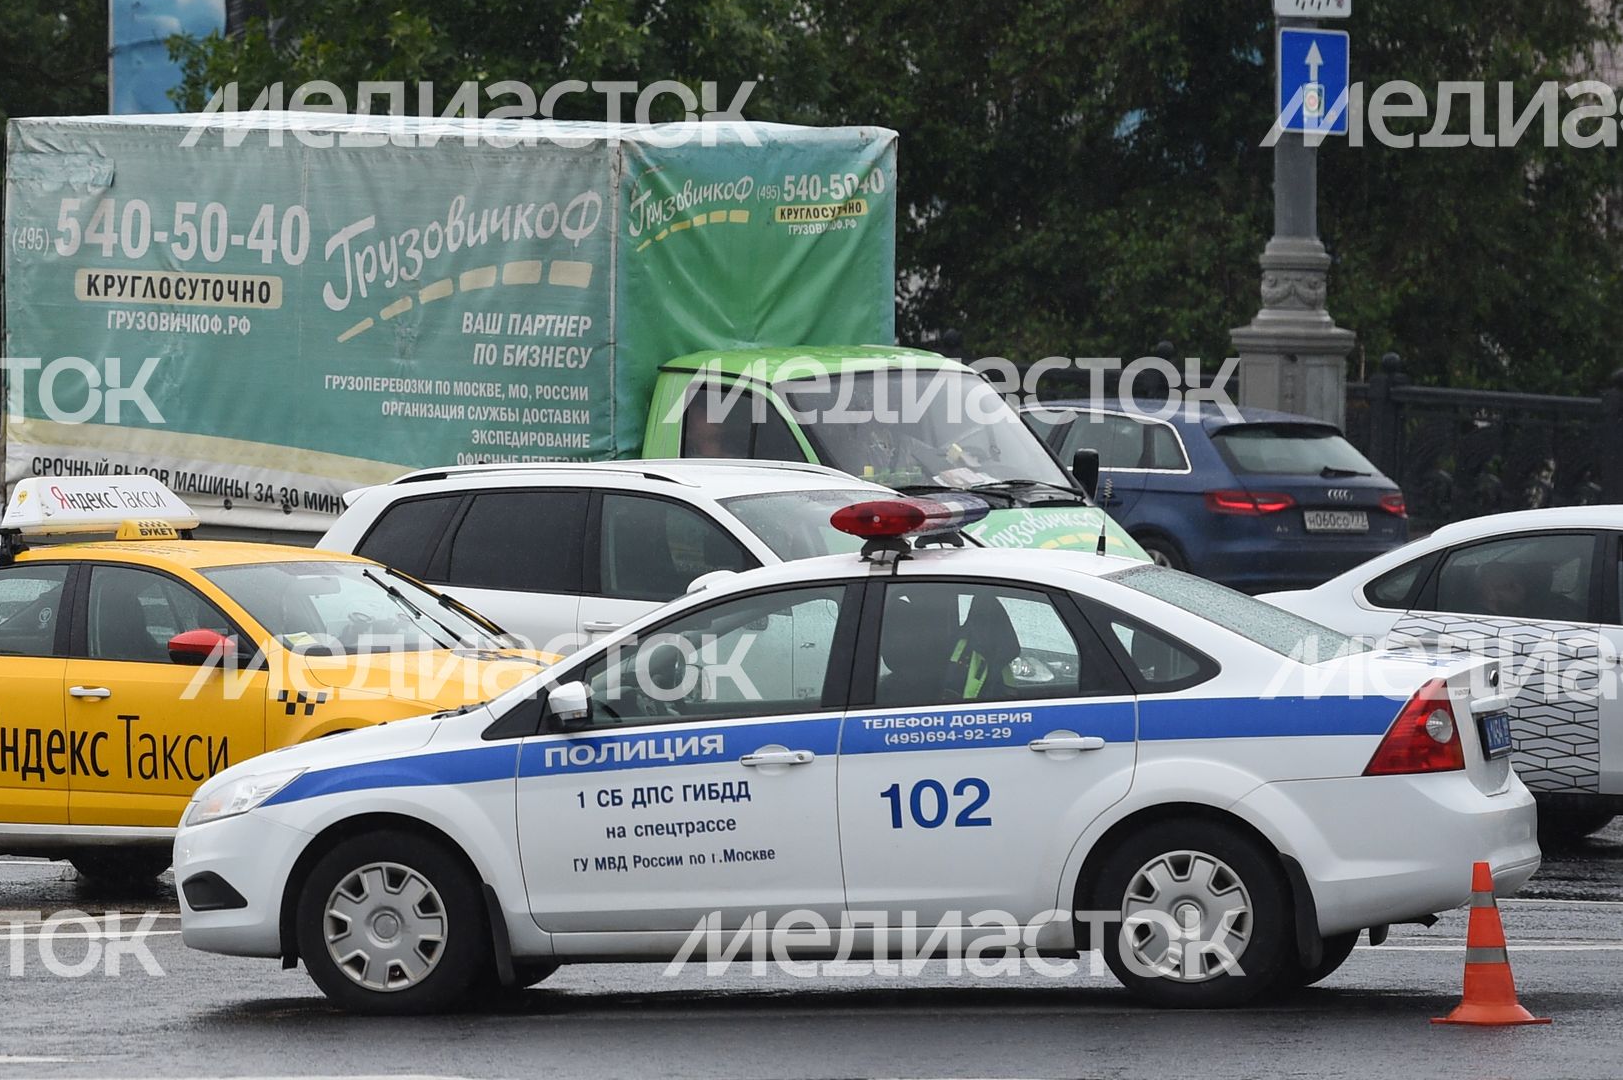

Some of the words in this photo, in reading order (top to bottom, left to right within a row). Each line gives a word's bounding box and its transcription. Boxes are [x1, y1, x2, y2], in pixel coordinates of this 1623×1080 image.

[757, 185, 780, 202] (495)
[12, 226, 50, 256] (495)
[54, 198, 310, 265] 540-50-40
[86, 273, 271, 304] КРУГЛОСУТОЧНО
[107, 310, 251, 336] ГРУЗОВИЧКОФ.РФ
[461, 311, 503, 334] ВАШ
[507, 313, 592, 338] ПАРТНЕР
[473, 343, 497, 366] ПО
[503, 344, 593, 369] БИЗНЕСУ
[325, 375, 432, 395] ГРУЗОПЕРЕВОЗКИ
[435, 380, 450, 396] ПО
[453, 381, 505, 401] МОСКВЕ,
[508, 384, 532, 402] МО,
[535, 385, 589, 401] РОССИИ
[381, 401, 465, 422] ОРГАНИЗАЦИЯ
[467, 405, 519, 421] СЛУЖБЫ
[522, 407, 590, 425] ДОСТАВКИ
[471, 429, 591, 449] ЭКСПЕДИРОВАНИЕ
[32, 457, 109, 477] СРОЧНЫЙ
[174, 470, 250, 500] МАШИНЫ
[253, 482, 275, 503] ЗА
[280, 486, 299, 508] 30
[50, 486, 117, 512] Яндекс
[109, 485, 166, 510] Такси
[138, 527, 174, 537] БУКЕТ
[863, 716, 944, 729] ТЕЛЕФОН
[950, 712, 1032, 727] ДОВЕРИЯ
[117, 714, 229, 781] Такси
[884, 727, 1012, 746] (495)694-92-29
[545, 734, 724, 768] ПОЛИЦИЯ
[577, 791, 585, 809] 1
[597, 789, 624, 808] СБ
[631, 785, 674, 809] ДПС
[682, 780, 752, 803] ГИБДД
[880, 777, 992, 829] 102
[606, 824, 626, 839] на
[634, 818, 737, 838] спецтрассе
[573, 857, 589, 872] ГУ
[594, 855, 629, 872] МВД
[633, 853, 684, 869] России
[689, 853, 706, 866] по
